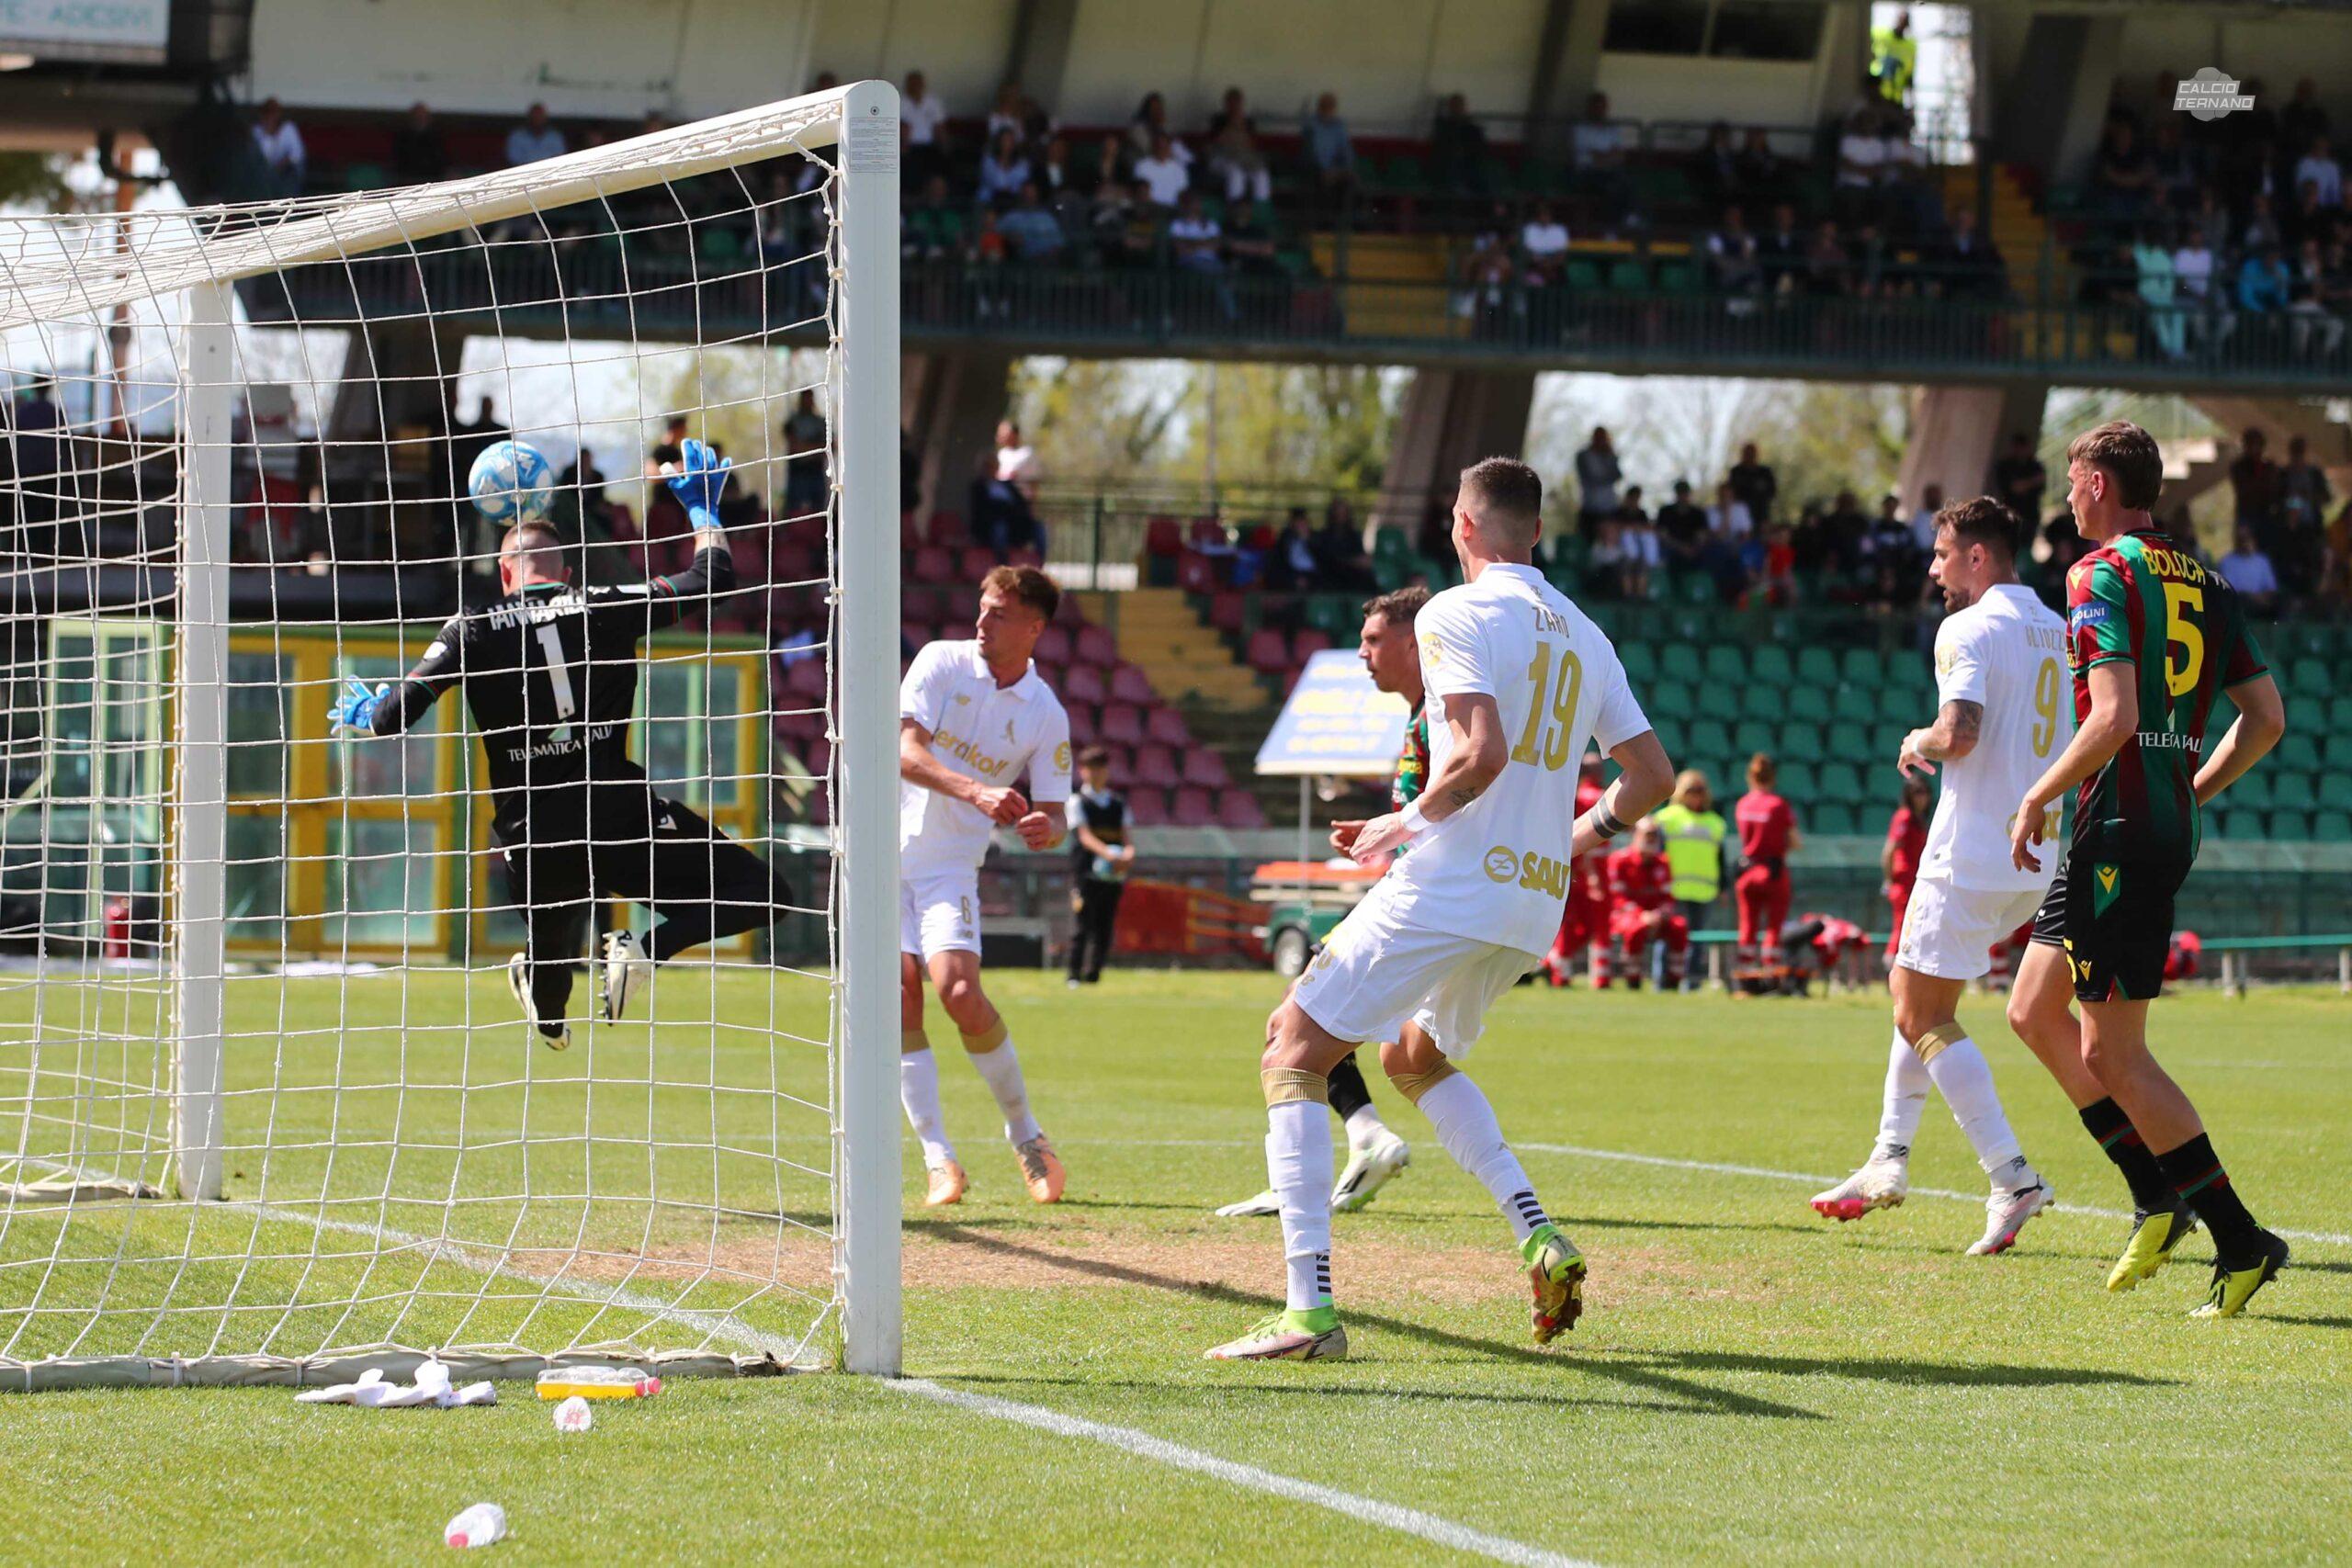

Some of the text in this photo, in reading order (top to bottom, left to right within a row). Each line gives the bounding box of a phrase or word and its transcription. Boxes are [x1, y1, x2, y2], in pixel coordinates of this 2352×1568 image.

[2139, 547, 2206, 586] BOLOCA
[535, 622, 576, 721] 1
[1531, 605, 1570, 639] ZARO
[2162, 581, 2205, 697] 5
[1510, 640, 1582, 772] 19
[2033, 656, 2061, 760] 9
